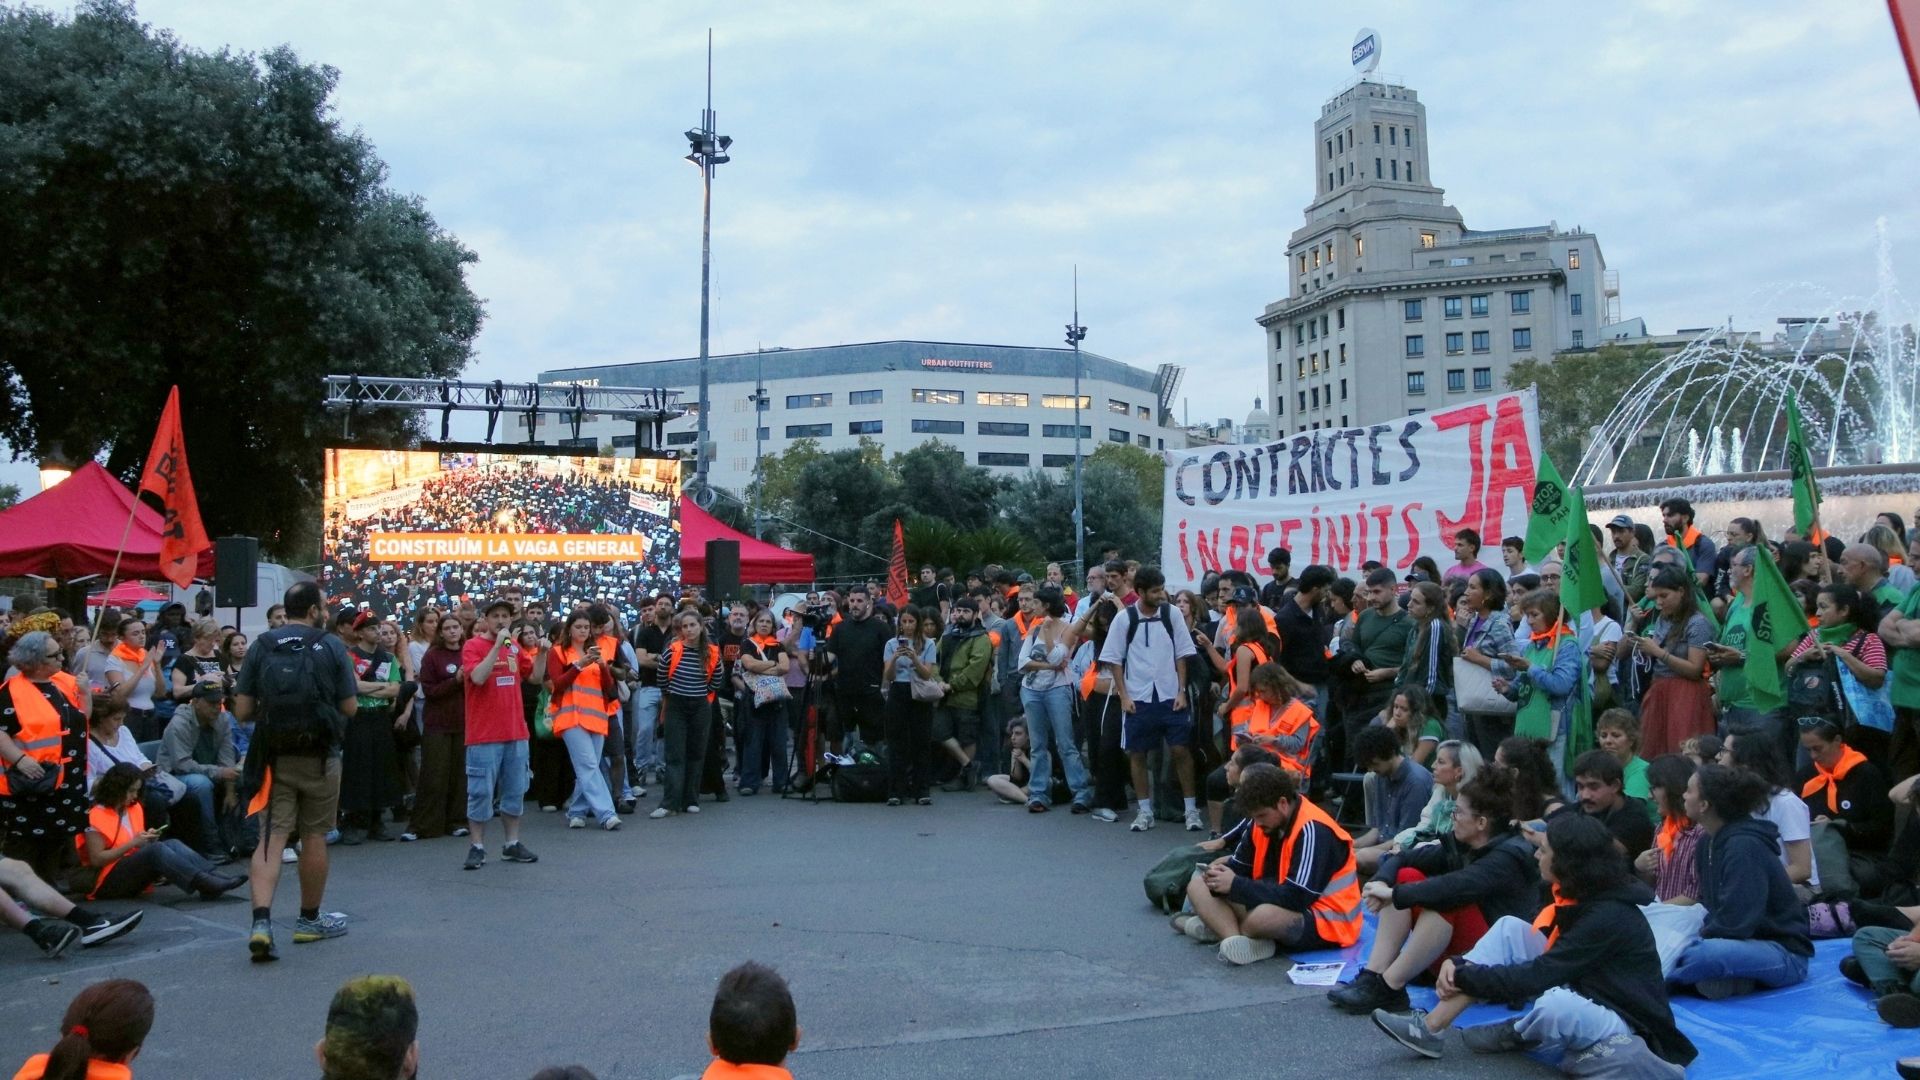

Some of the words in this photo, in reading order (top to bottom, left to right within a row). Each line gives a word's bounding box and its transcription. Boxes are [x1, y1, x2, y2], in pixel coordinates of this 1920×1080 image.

[1353, 40, 1374, 60] BBVA
[921, 358, 947, 367] URBAN
[948, 359, 993, 369] OUTFITTERS
[1176, 421, 1422, 506] CONTRACTES
[1533, 483, 1554, 510] STOP
[1550, 505, 1570, 525] PAH
[375, 537, 482, 556] CONSTRUÏM
[488, 539, 510, 556] LA
[514, 539, 559, 556] VAGA
[562, 540, 639, 557] GENERAL
